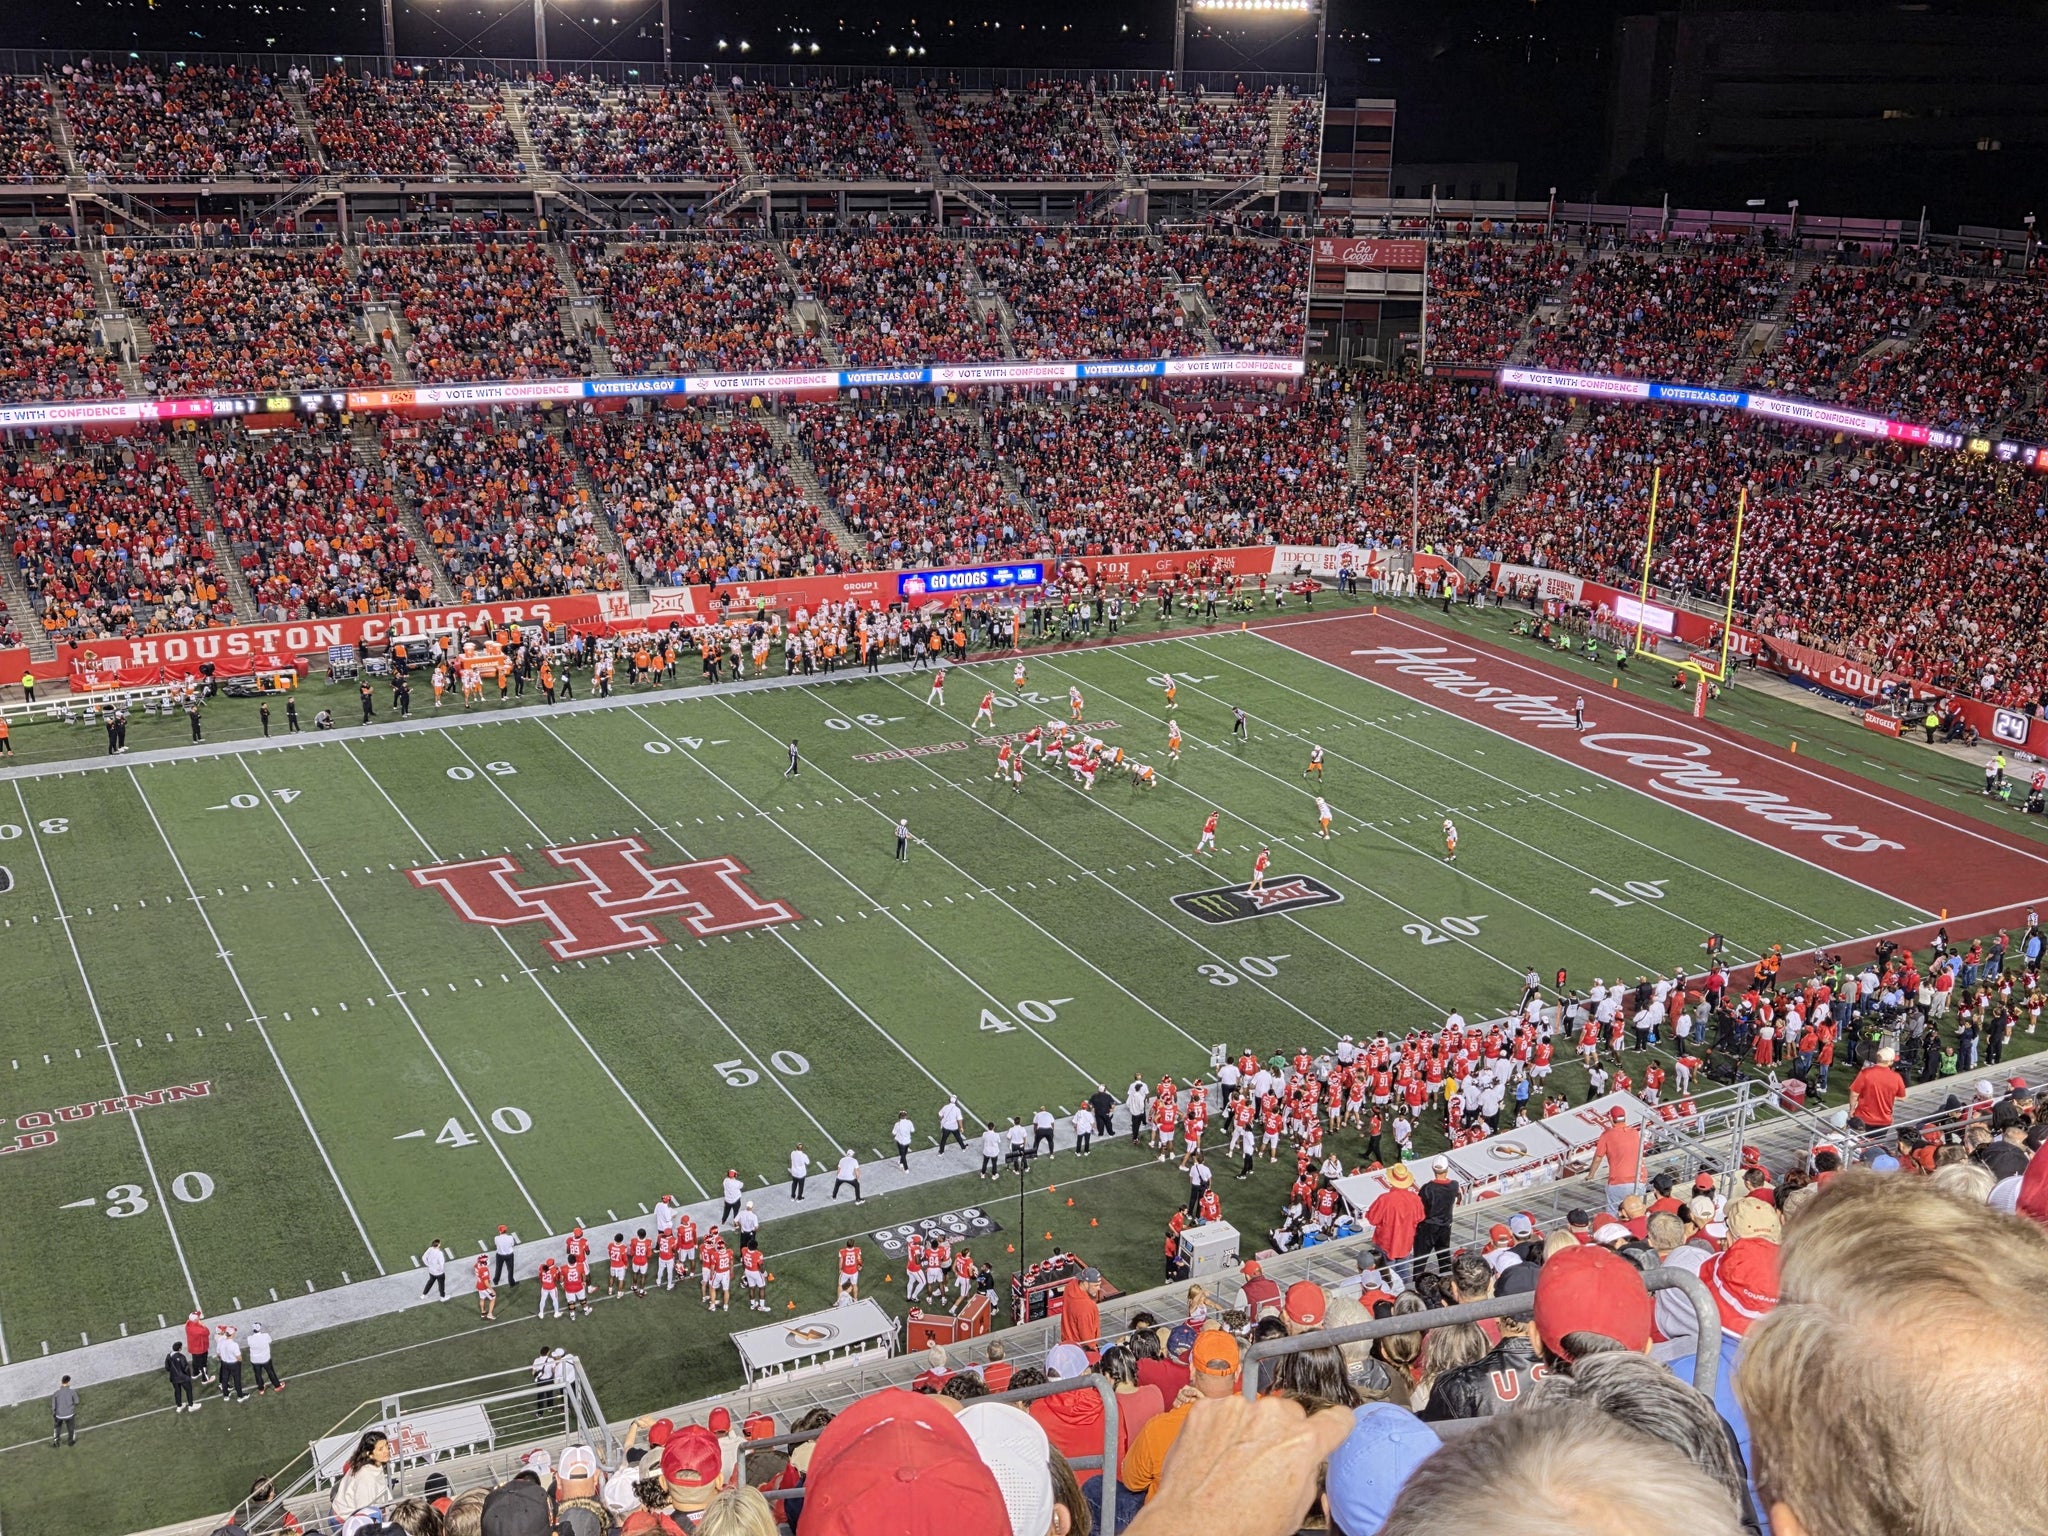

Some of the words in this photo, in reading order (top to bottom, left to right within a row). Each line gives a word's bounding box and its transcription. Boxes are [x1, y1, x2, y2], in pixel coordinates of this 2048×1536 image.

[1355, 240, 1371, 254] Go
[1342, 248, 1379, 265] Coogs!
[957, 368, 985, 379] VOTE
[986, 367, 1007, 378] WITH
[1009, 366, 1066, 378] CONFIDENCE
[1083, 363, 1157, 376] VOTETEXAS.GOV
[1188, 361, 1210, 372] VOTE
[1211, 360, 1234, 371] WITH
[1235, 360, 1293, 372] CONFIDENCE
[713, 378, 739, 388] VOTE
[740, 377, 766, 387] WITH
[767, 375, 828, 387] CONFIDENCE
[846, 370, 923, 383] VOTETEXAS.GOV
[591, 381, 675, 393] VOTETEXAS.GOV
[1529, 374, 1553, 386] VOTE
[1554, 376, 1578, 388] WITH
[1579, 378, 1640, 395] CONFIDENCE
[446, 389, 473, 400] VOTE
[476, 388, 502, 398] WITH
[504, 385, 570, 397] CONFIDENCE
[1659, 387, 1740, 404] VOTETEXAS.GOV
[14, 410, 46, 420] WITH
[49, 406, 127, 419] CONFIDENCE
[170, 403, 178, 414] 7
[213, 400, 233, 412] 2ND
[247, 400, 256, 412] 7
[1769, 402, 1793, 416] VOTE
[1793, 405, 1813, 419] WITH
[1814, 410, 1866, 429] CONFIDENCE
[1896, 426, 1903, 436] 7
[1928, 431, 1944, 444] 2ND
[1971, 439, 1990, 452] 4:56
[2002, 451, 2012, 460] 22
[1280, 551, 1320, 563] TDECU
[843, 582, 873, 591] GROUP
[930, 575, 947, 588] GO
[949, 571, 988, 586] COOGS
[1547, 578, 1576, 591] STUDENT
[362, 603, 551, 642] COUGARS
[129, 623, 341, 665] HOUSTON
[1689, 656, 1715, 672] SEATGEEK
[1350, 646, 1597, 730] Houston
[991, 691, 1050, 708] 20
[823, 713, 887, 732] 30
[1864, 712, 1897, 731] SEATGEEK
[1996, 713, 2024, 739] 24
[643, 735, 706, 755] 40
[852, 740, 969, 763] TDECU
[446, 760, 518, 781] 50
[229, 787, 303, 810] 40
[1579, 733, 1906, 852] Cougars
[1588, 879, 1665, 908] 10
[1401, 915, 1481, 945] 20
[1197, 955, 1279, 986] 30
[979, 999, 1057, 1034] 40
[713, 1049, 810, 1087] 50
[1379, 1077, 1388, 1087] 91
[1408, 1084, 1417, 1094] 77
[16, 1080, 211, 1130] QUINN
[434, 1106, 533, 1148] 40
[105, 1171, 215, 1218] 30
[684, 1231, 693, 1242] 81
[635, 1246, 646, 1256] 83
[887, 1241, 898, 1249] 10
[610, 1251, 621, 1261] 27
[719, 1258, 730, 1269] 82
[567, 1272, 579, 1282] 62
